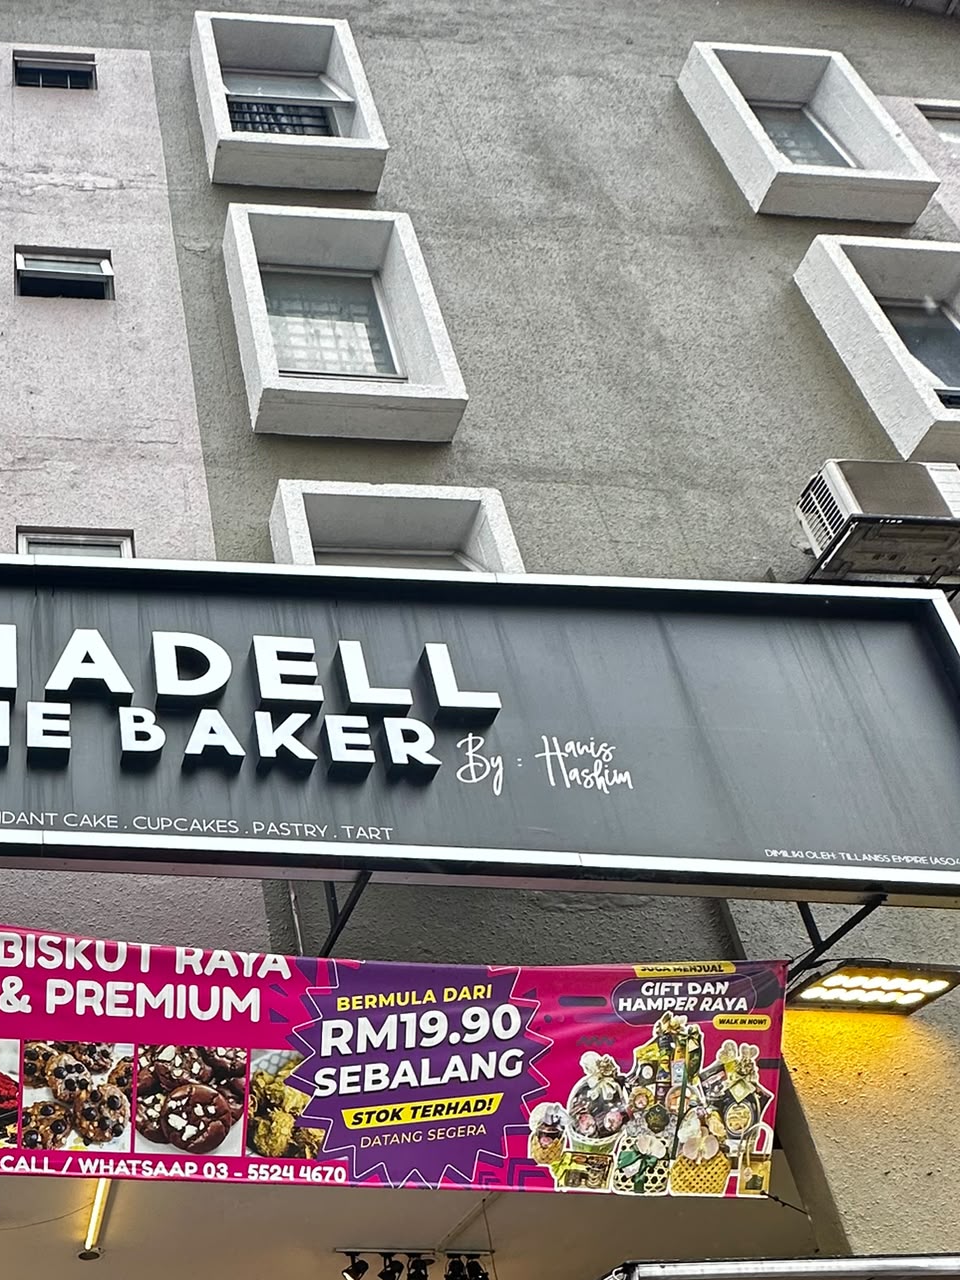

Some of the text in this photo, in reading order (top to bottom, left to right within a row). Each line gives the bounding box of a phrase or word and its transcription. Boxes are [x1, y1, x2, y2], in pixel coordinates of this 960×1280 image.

[118, 706, 442, 766] BAKER
[456, 733, 503, 796] By
[534, 735, 616, 766] Hanis
[63, 813, 118, 828] CAKE
[133, 816, 239, 834] CUPCAKES
[253, 821, 329, 838] PASTRY
[341, 825, 393, 840] TART
[892, 855, 929, 865] EMPIRE
[175, 946, 292, 980] RAYA
[45, 978, 260, 1022] PREMIUM
[336, 984, 493, 1012] BERMULA DARI
[641, 981, 729, 996] GIFT DAN
[618, 997, 748, 1012] HAMPER RAYA
[320, 1003, 522, 1057] RM19.90
[313, 1048, 525, 1098] SEBALANG
[351, 1098, 494, 1126] STOK TERHAD!
[360, 1124, 487, 1149] DATANG SEGERA
[0, 1155, 54, 1173] CALL
[78, 1158, 199, 1178] WHATSAAP
[203, 1161, 229, 1180] 03
[247, 1163, 295, 1182] 5524
[299, 1165, 347, 1183] 4670
